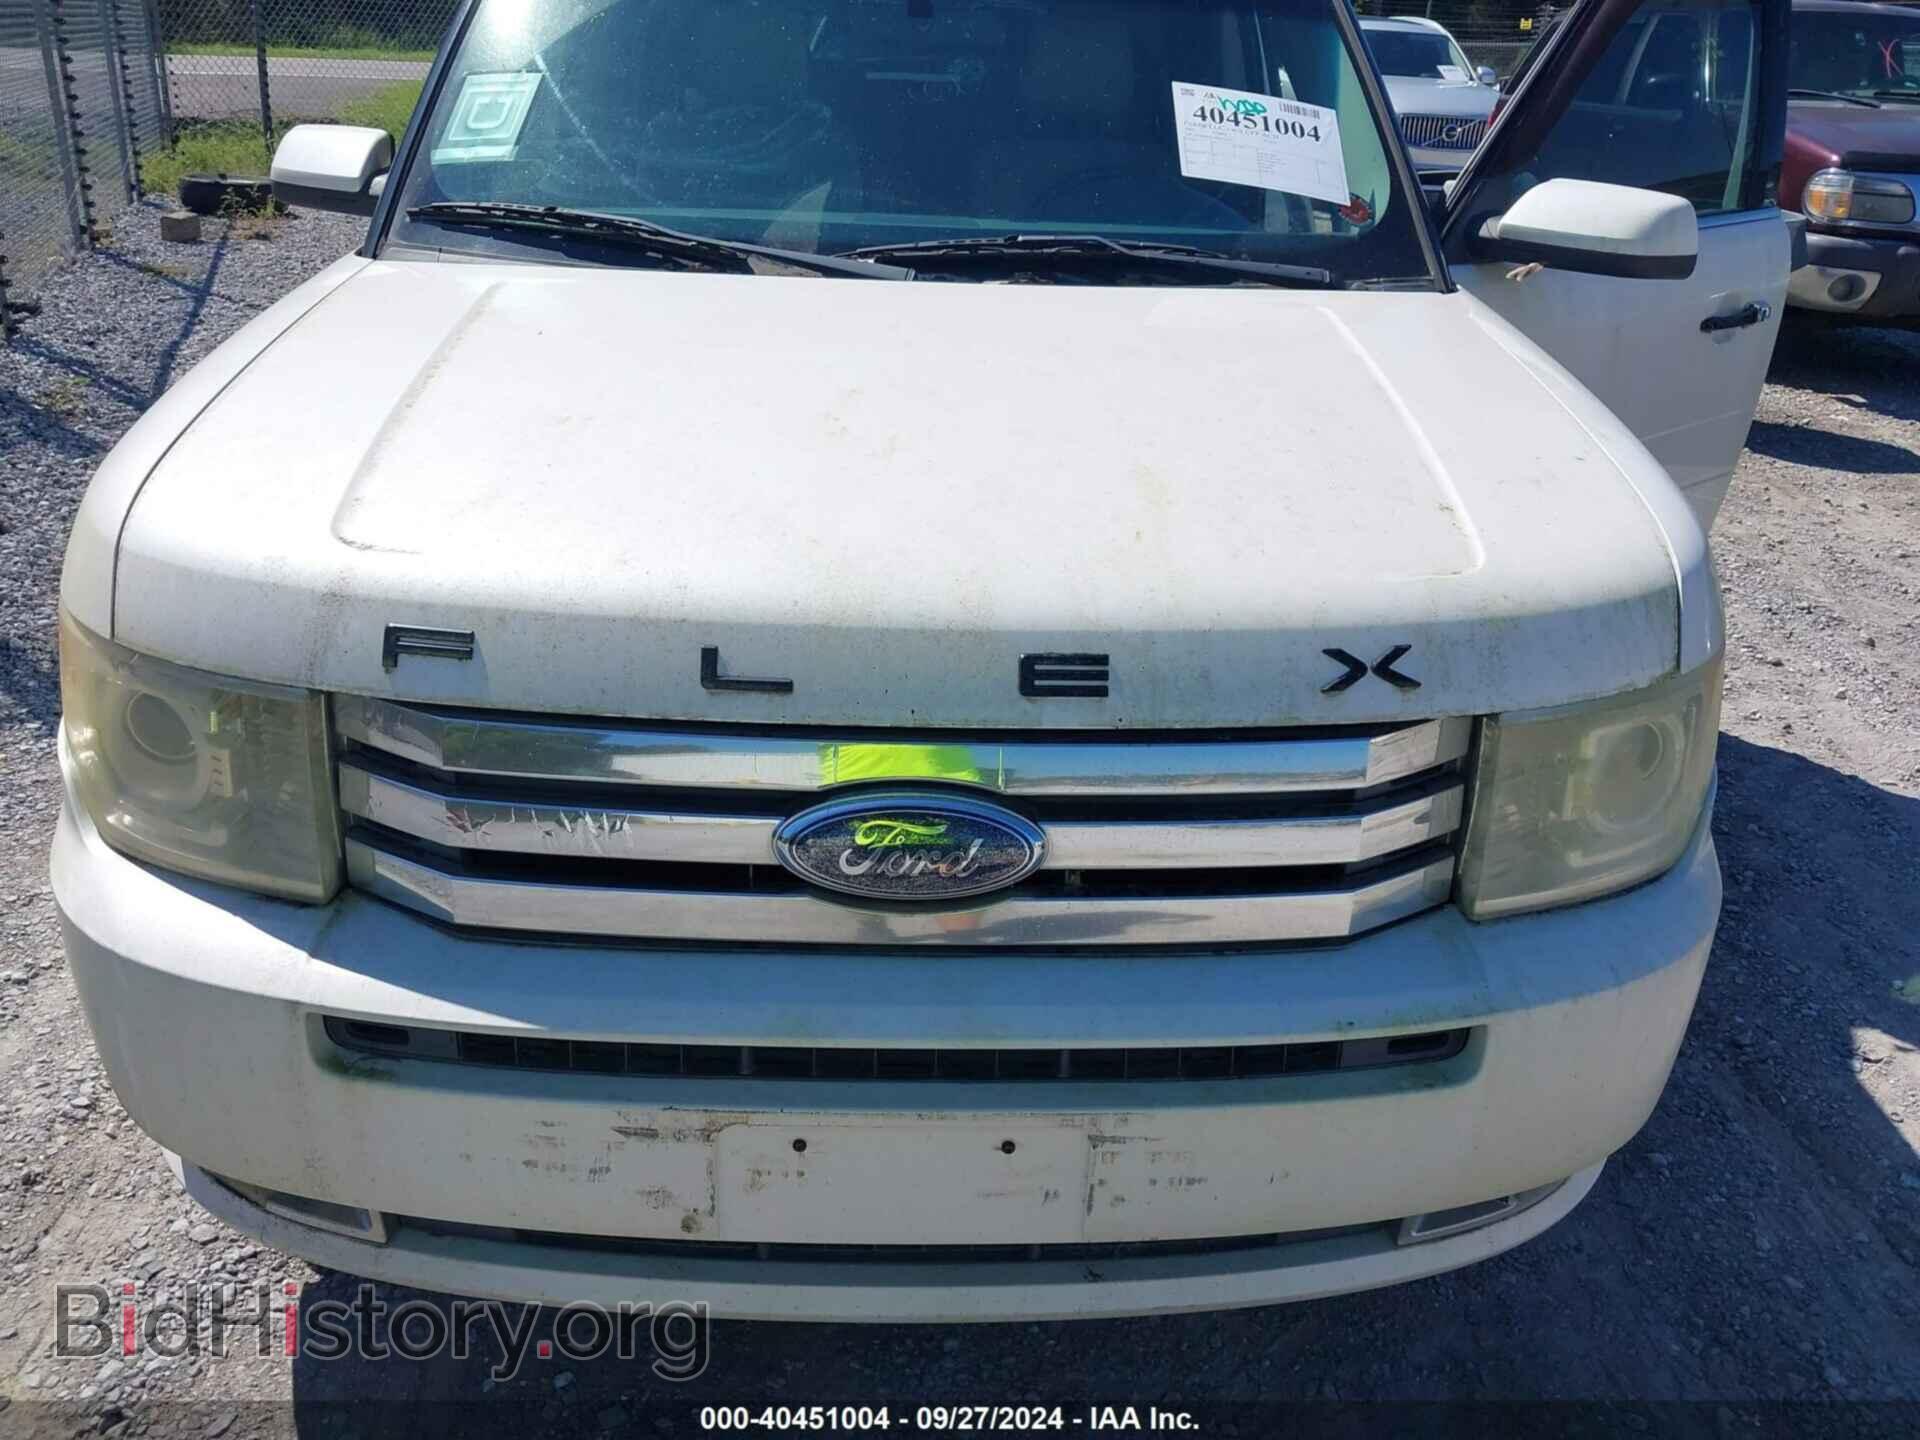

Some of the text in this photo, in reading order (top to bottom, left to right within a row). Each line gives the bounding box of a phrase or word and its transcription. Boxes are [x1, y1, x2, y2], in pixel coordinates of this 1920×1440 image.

[1192, 104, 1321, 142] 40451004
[382, 623, 1422, 698] FLEX
[838, 819, 985, 878] Ford
